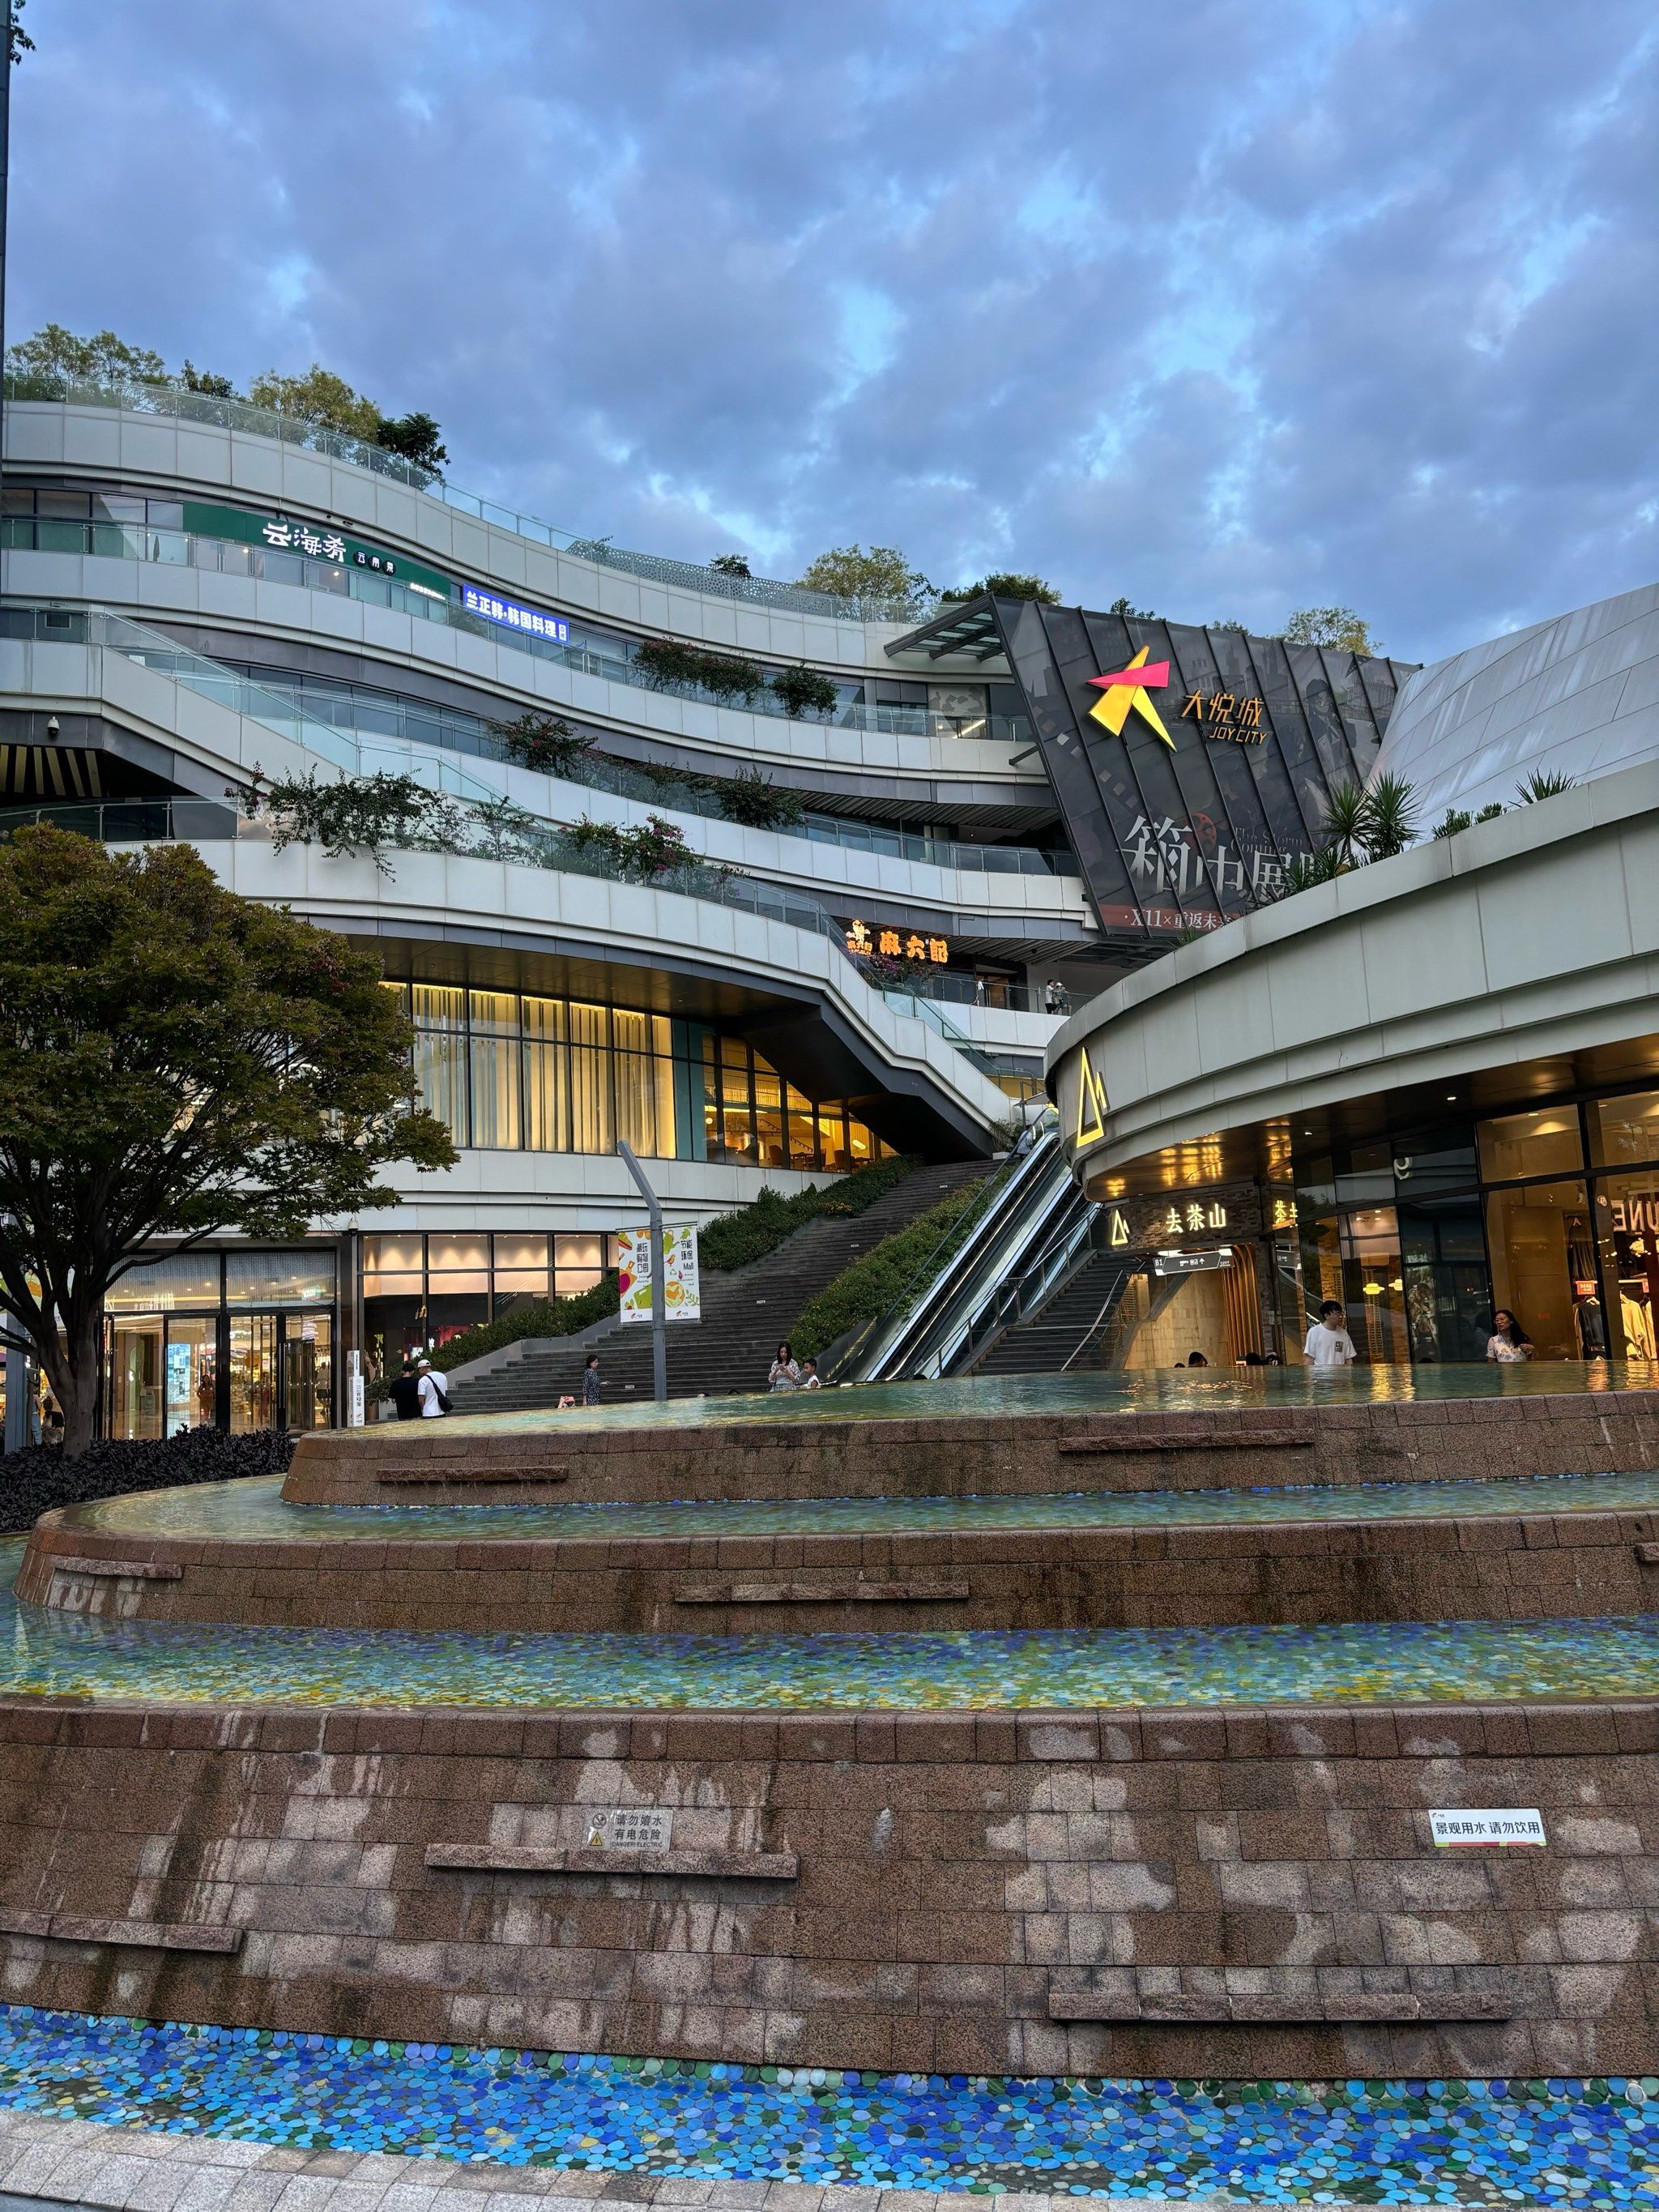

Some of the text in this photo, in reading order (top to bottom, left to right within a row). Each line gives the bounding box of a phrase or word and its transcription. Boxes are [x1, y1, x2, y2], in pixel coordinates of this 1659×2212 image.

[262, 522, 347, 562] 云海肴
[466, 591, 557, 638] 兰正韩·韩国料理
[1180, 689, 1264, 728] 大悦城
[1209, 726, 1268, 745] JOY CITY
[1115, 815, 1316, 901] 箱中展
[1166, 1202, 1226, 1233] 去茶山
[1154, 1258, 1163, 1266] B1
[616, 1814, 663, 1826] 请勿嬉水
[1435, 1821, 1541, 1835] 景观用水 请勿饮用
[615, 1829, 662, 1840] 有电危险
